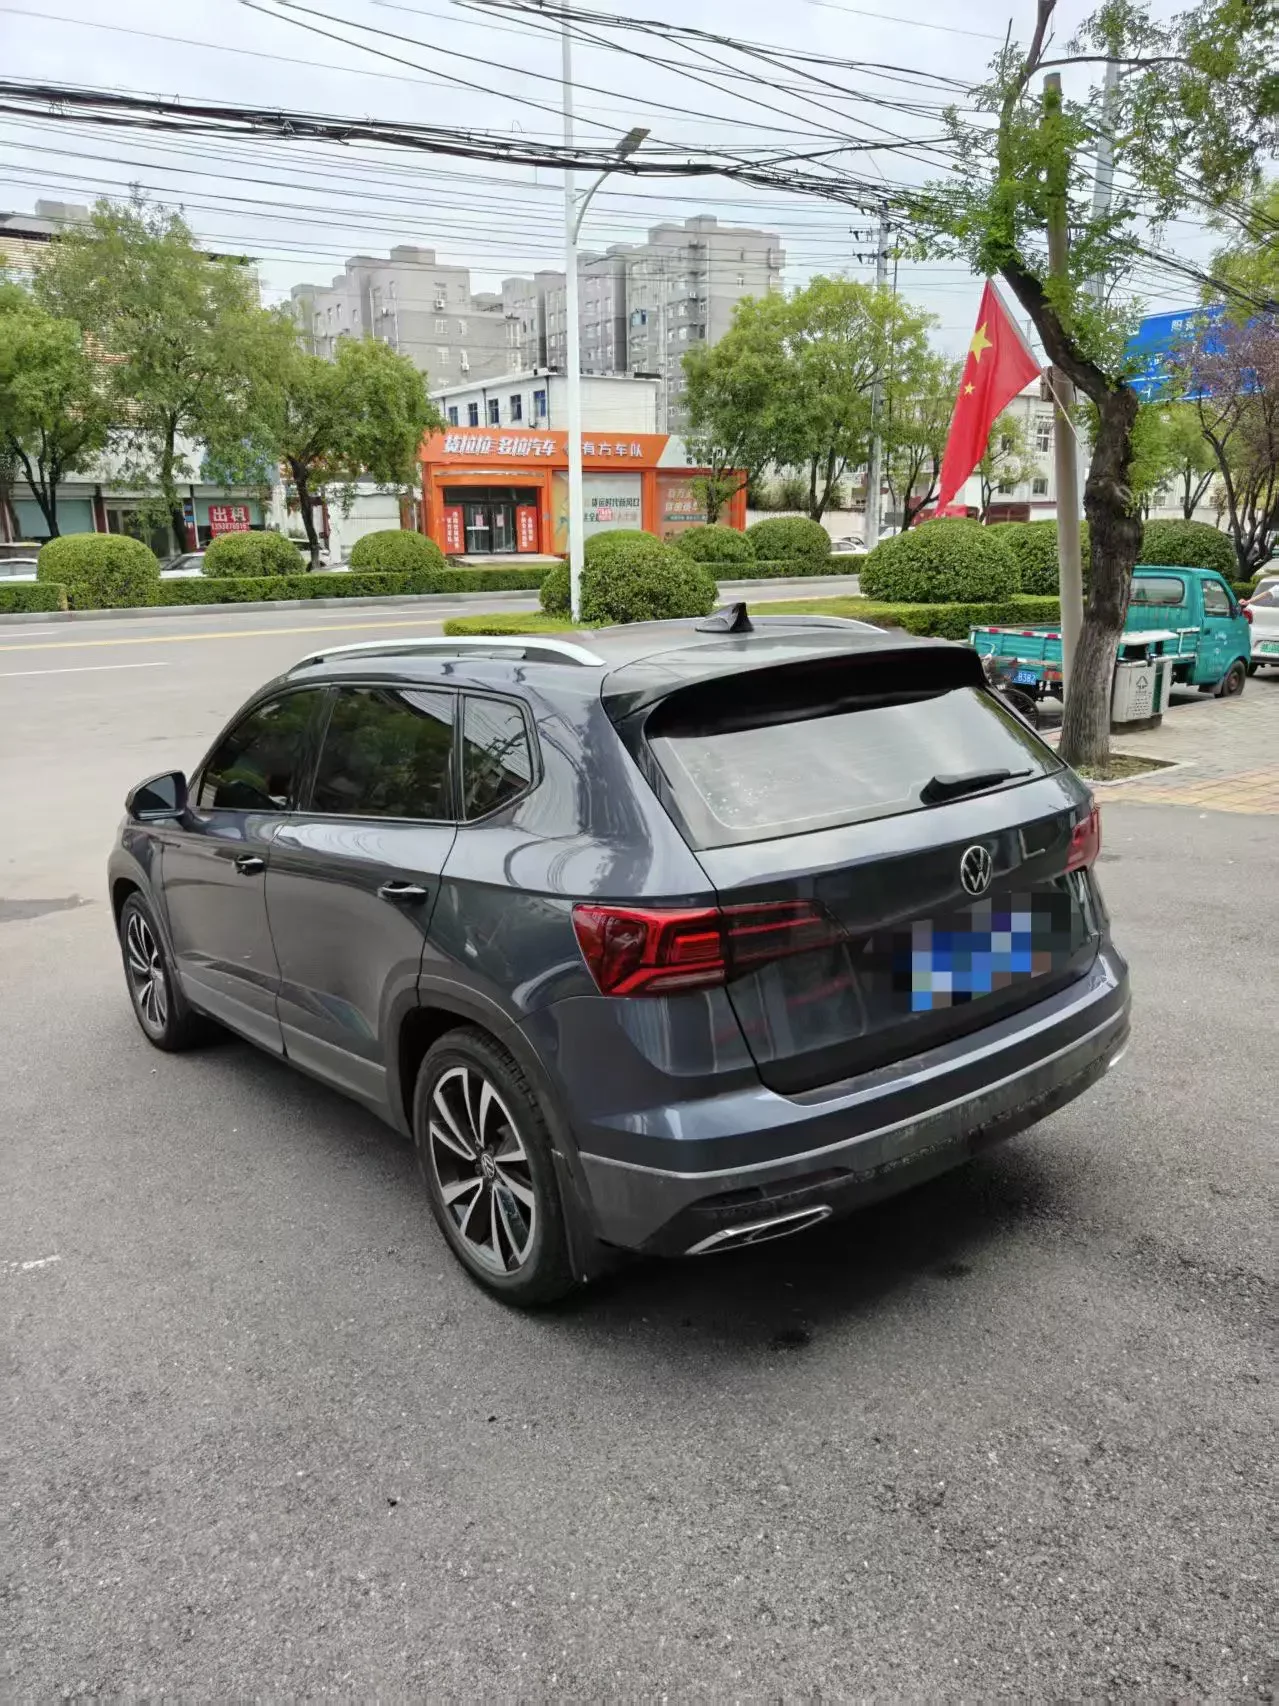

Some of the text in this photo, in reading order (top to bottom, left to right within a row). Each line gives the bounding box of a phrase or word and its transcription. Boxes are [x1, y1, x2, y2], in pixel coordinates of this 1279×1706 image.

[583, 441, 643, 457] 有方车队
[213, 507, 246, 522] 出租
